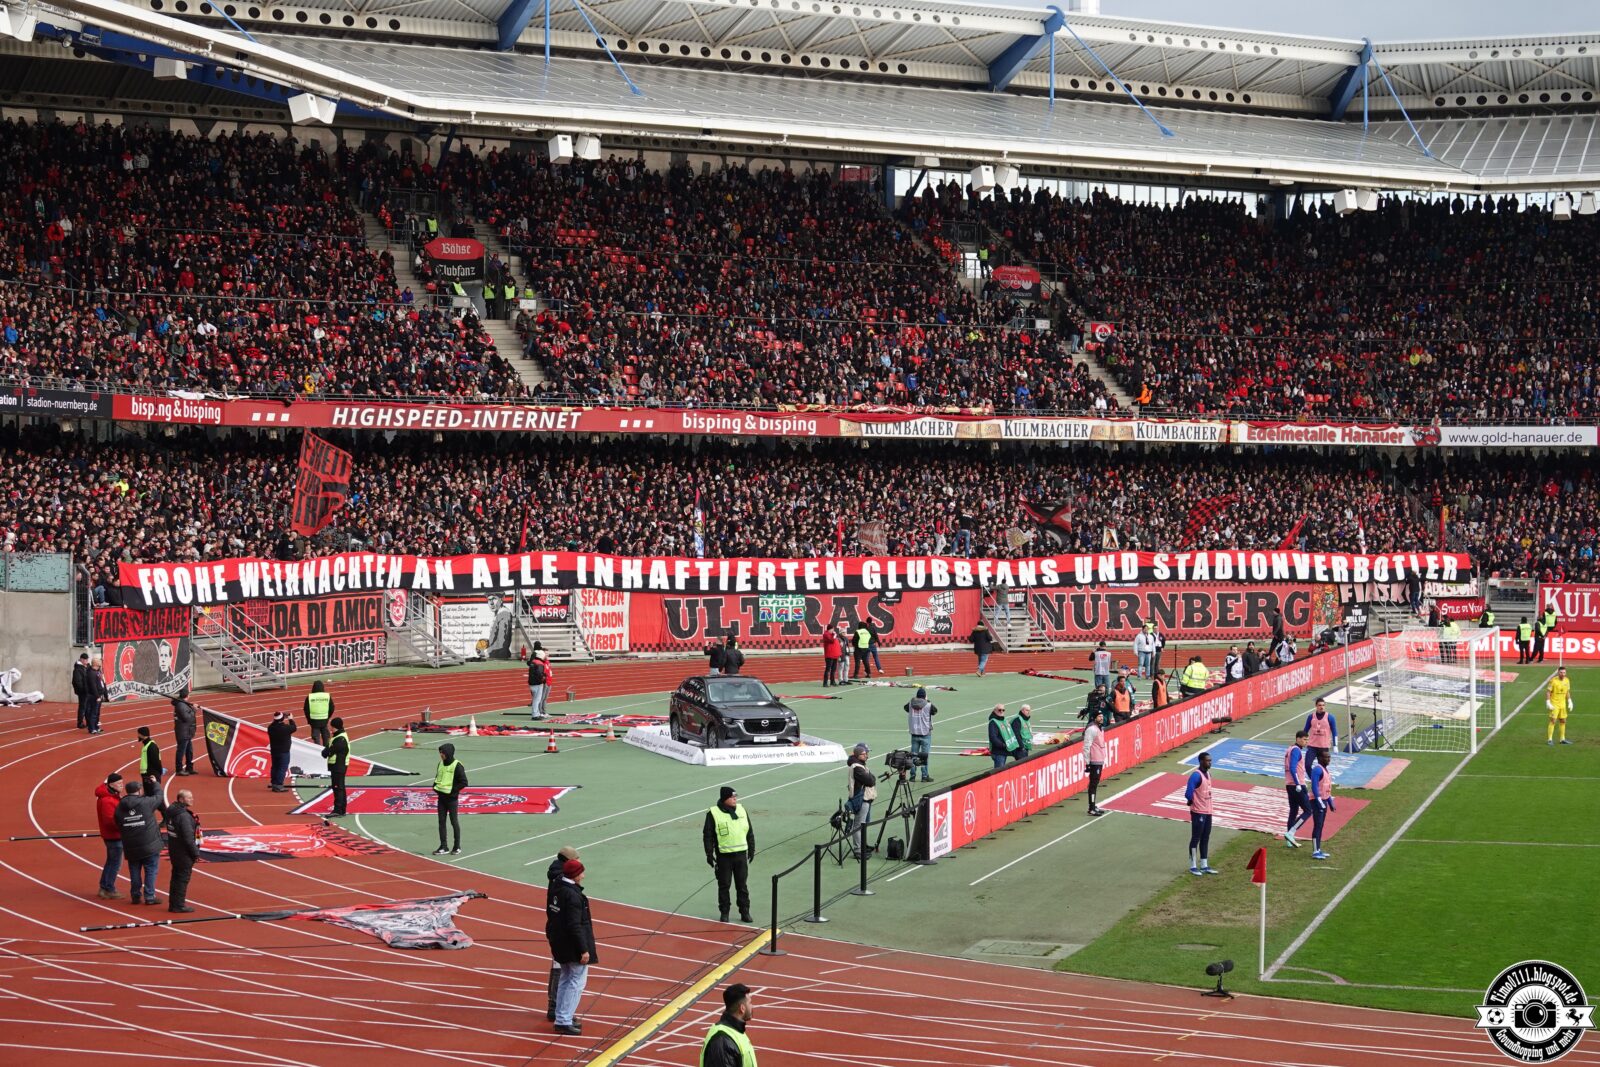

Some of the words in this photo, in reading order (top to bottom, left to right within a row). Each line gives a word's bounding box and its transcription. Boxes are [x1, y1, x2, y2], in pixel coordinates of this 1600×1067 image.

[441, 243, 471, 255] Böhse
[27, 396, 98, 413] stadion-nuernberg.de
[131, 397, 171, 421] bispng
[173, 400, 182, 417] &
[183, 401, 221, 424] bisping
[332, 407, 582, 429] HIGHSPEED-INTERNET
[682, 412, 741, 433] bisping
[744, 414, 757, 429] &
[759, 415, 817, 435] bisping
[864, 420, 953, 436] KULMBACHER
[1004, 419, 1088, 438] KULMBACHER
[1136, 421, 1217, 440] KULMBACHER
[1246, 426, 1336, 443] Edelmetalle
[1341, 427, 1405, 444] Hanauer
[1448, 431, 1583, 446] www.gold-hanauer.de
[138, 564, 228, 605] FROHE
[239, 555, 403, 598] WEIHNACHTEN
[411, 558, 454, 590] AN
[472, 554, 559, 589] ALLE
[577, 555, 844, 592] INHAFTIERTEN
[862, 559, 1060, 590] GLUBBFANS
[1074, 552, 1138, 585] UND
[581, 588, 624, 606] SEKTION
[1543, 587, 1600, 617] KUL
[307, 602, 328, 635] DI
[333, 597, 384, 633] AMICI
[1032, 586, 1311, 632] NÜRNBERG
[95, 611, 128, 638] KAOS
[143, 608, 188, 636] BAGAGE
[581, 611, 624, 628] STADION
[291, 642, 319, 671] FÜR
[1155, 692, 1234, 745] FCN.DE/MITGLIEDSCHAFT
[729, 752, 741, 760] Wir
[742, 750, 785, 760] mobilisieren
[786, 749, 799, 758] den
[964, 810, 976, 825] FCN
